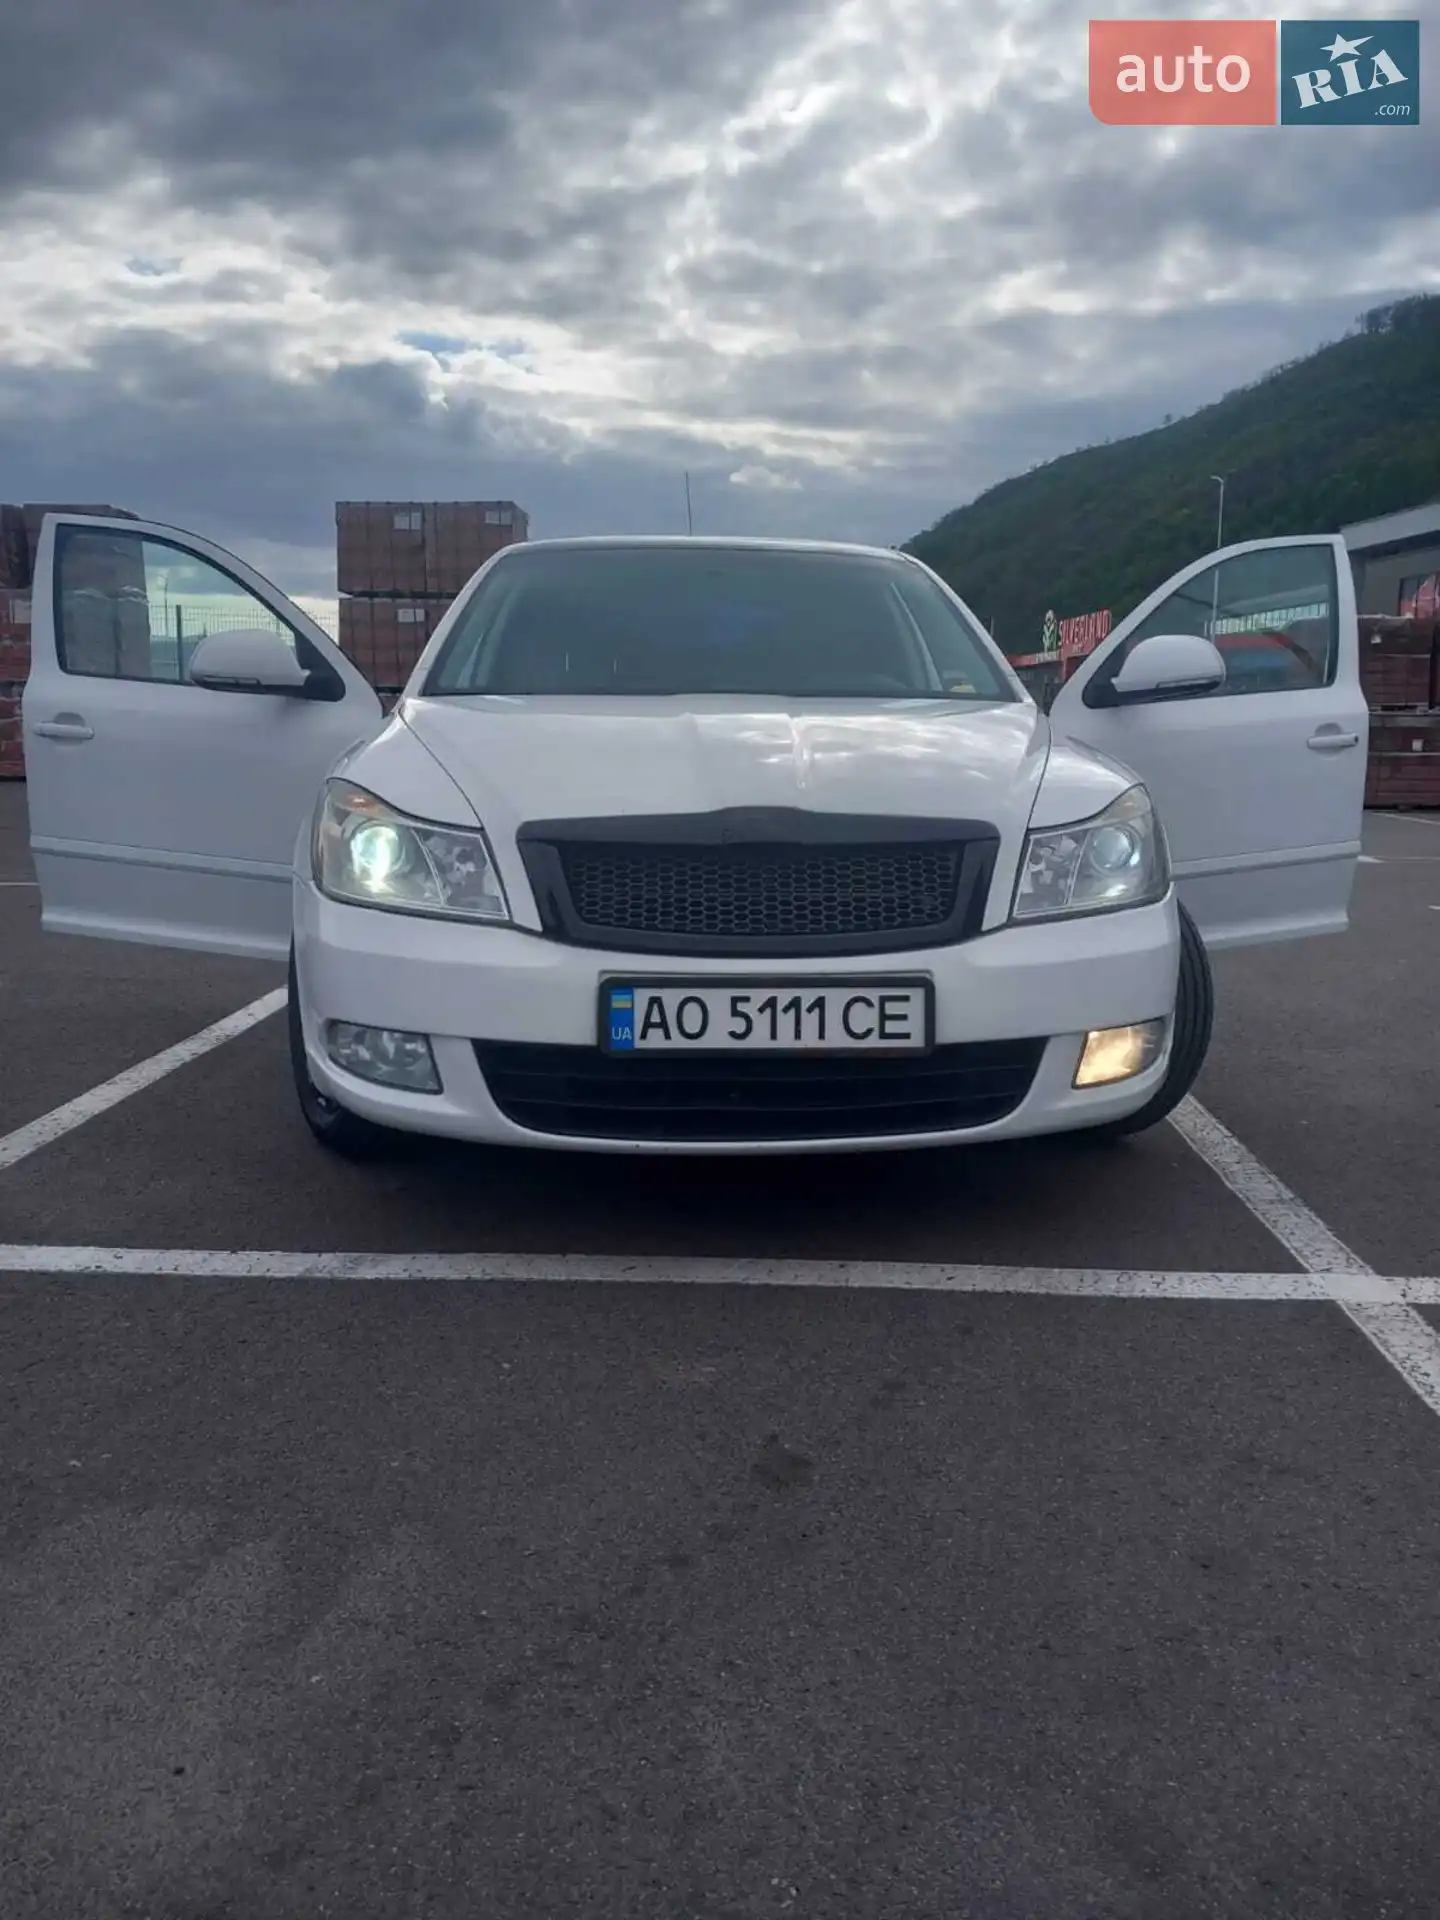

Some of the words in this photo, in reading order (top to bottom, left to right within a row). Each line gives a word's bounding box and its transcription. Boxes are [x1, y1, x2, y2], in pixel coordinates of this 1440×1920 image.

[639, 995, 709, 1041] AO
[727, 995, 826, 1041] 5111
[842, 994, 911, 1041] CE
[611, 1027, 632, 1040] UA
